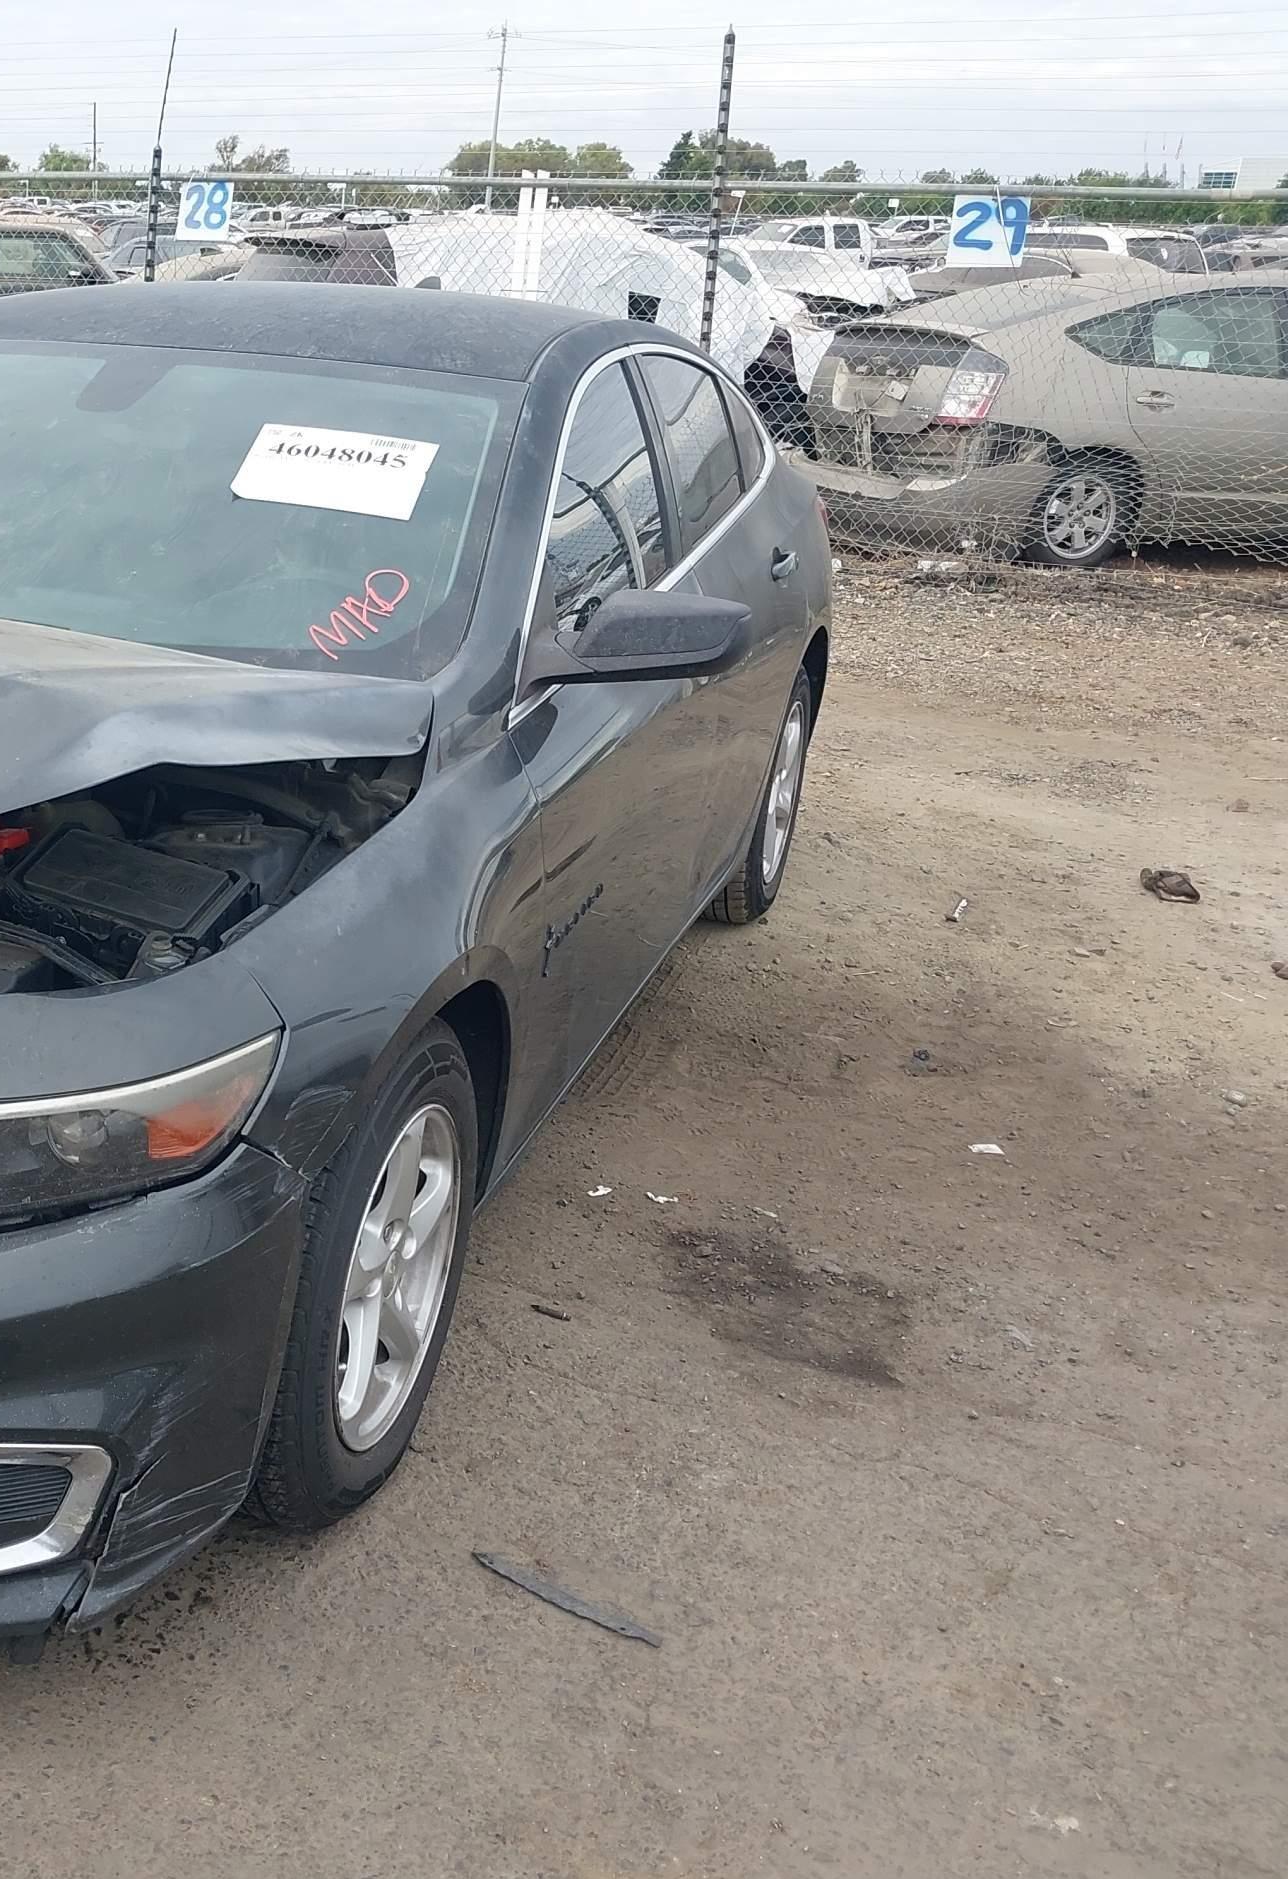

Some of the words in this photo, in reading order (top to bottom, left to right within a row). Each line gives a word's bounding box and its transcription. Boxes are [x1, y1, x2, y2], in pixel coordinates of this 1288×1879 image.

[184, 180, 229, 230] 28
[953, 197, 1028, 256] 29
[268, 441, 407, 469] 46048045
